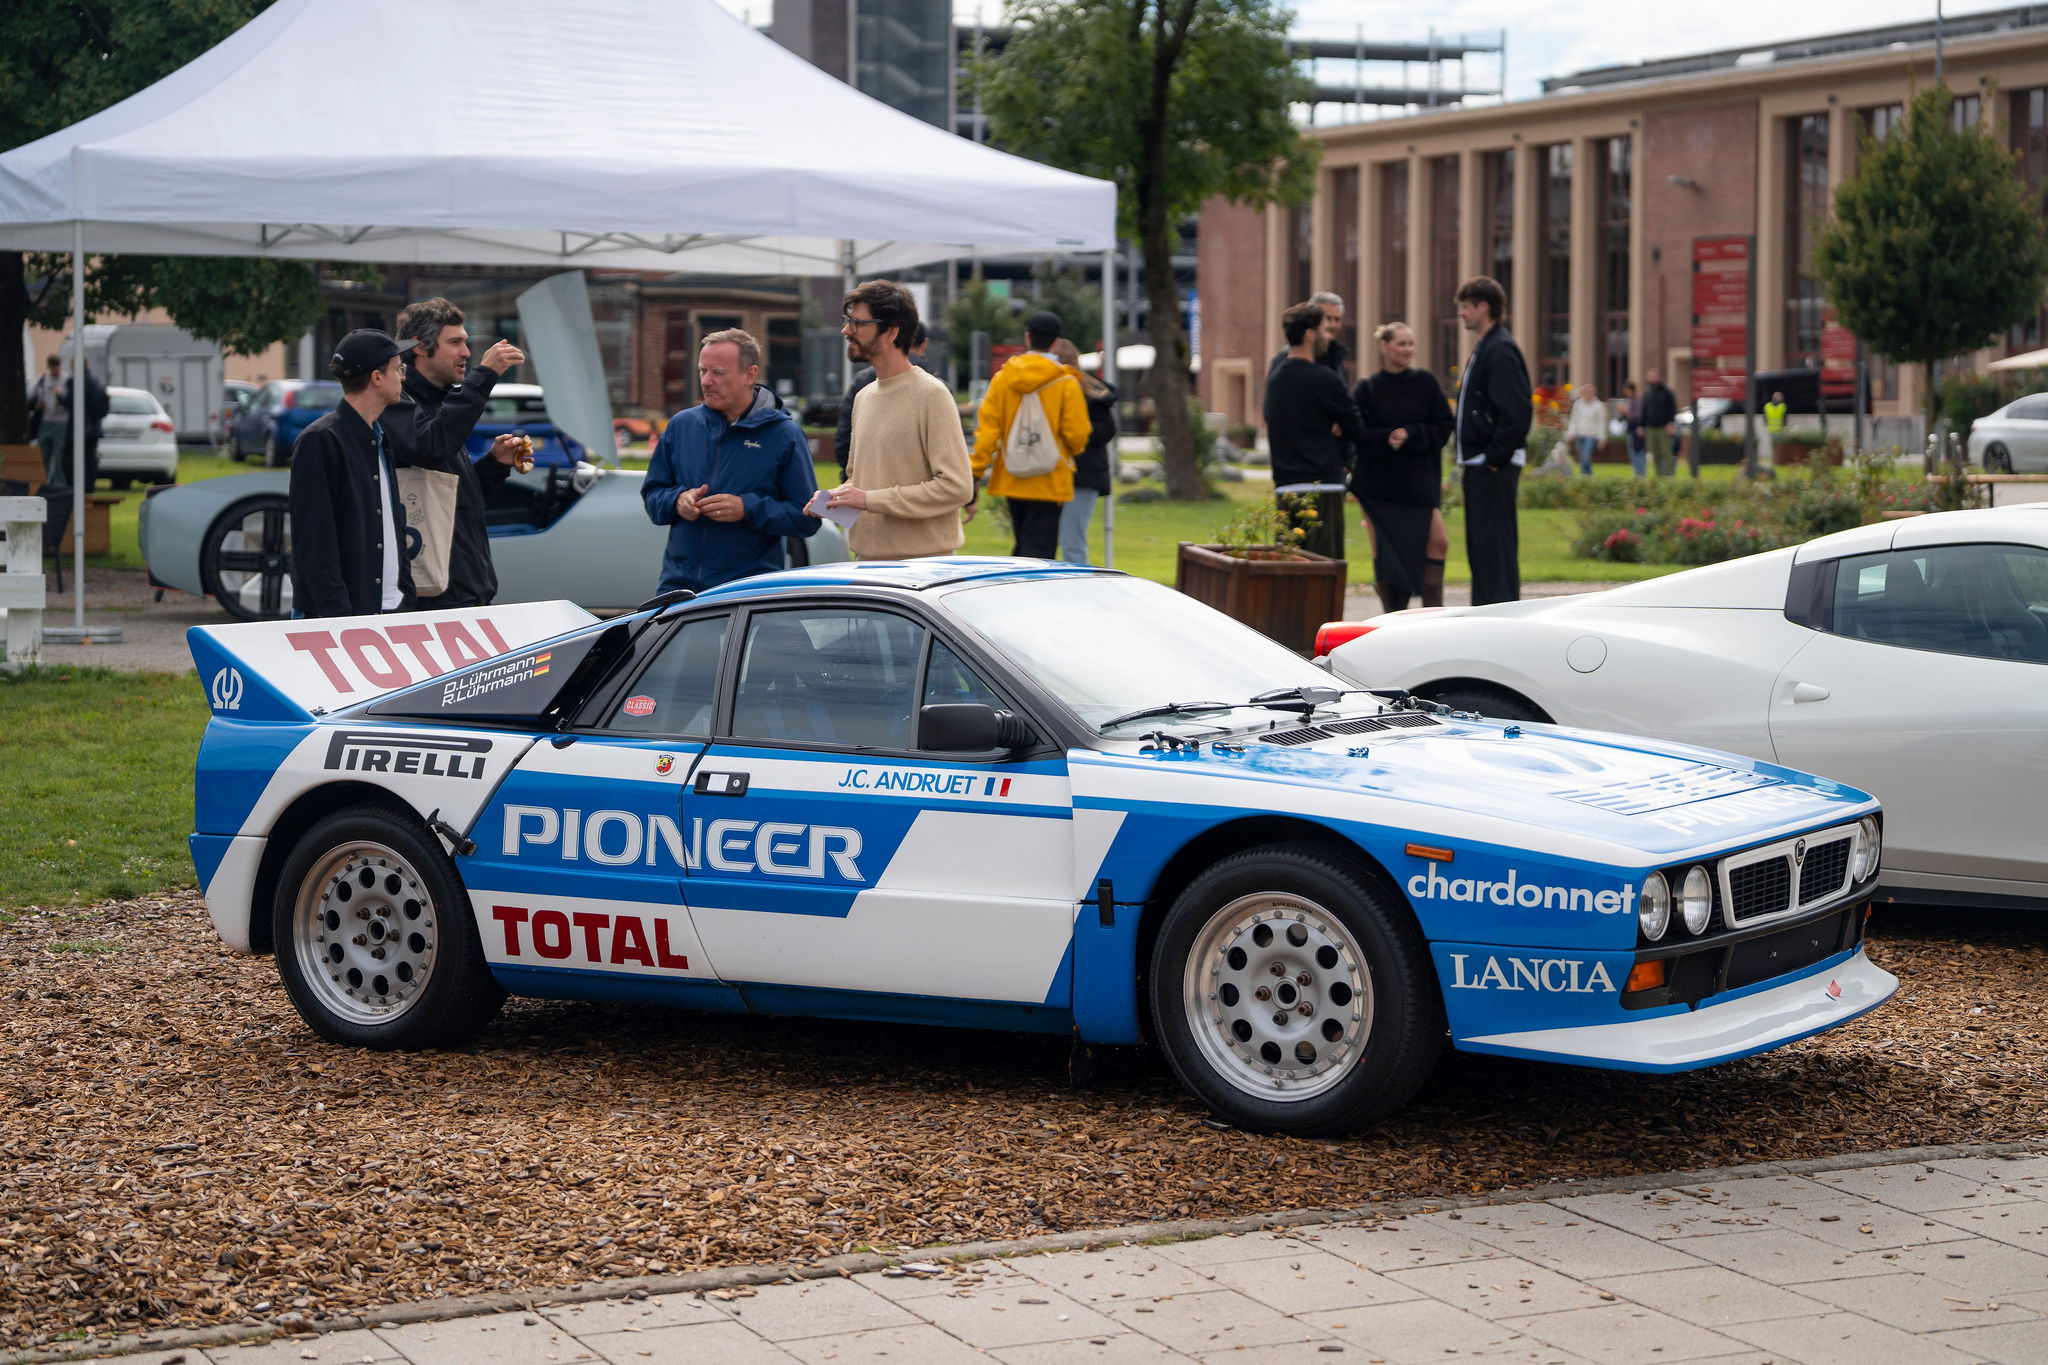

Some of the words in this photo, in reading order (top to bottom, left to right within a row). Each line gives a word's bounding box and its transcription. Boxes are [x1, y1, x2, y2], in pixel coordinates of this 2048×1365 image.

[441, 668, 534, 708] R.Lührmann
[443, 655, 536, 695] D.Lührmann
[626, 700, 655, 710] CLASSIC
[323, 730, 494, 780] PIRELLI
[837, 768, 870, 790] J.C.
[873, 770, 978, 796] ANDRUET
[502, 803, 867, 882] PIONEER
[1272, 902, 1313, 914] SPEEDLINE
[1406, 861, 1637, 916] chardonnet
[491, 905, 690, 970] TOTAL
[1450, 953, 1617, 994] LANCIA
